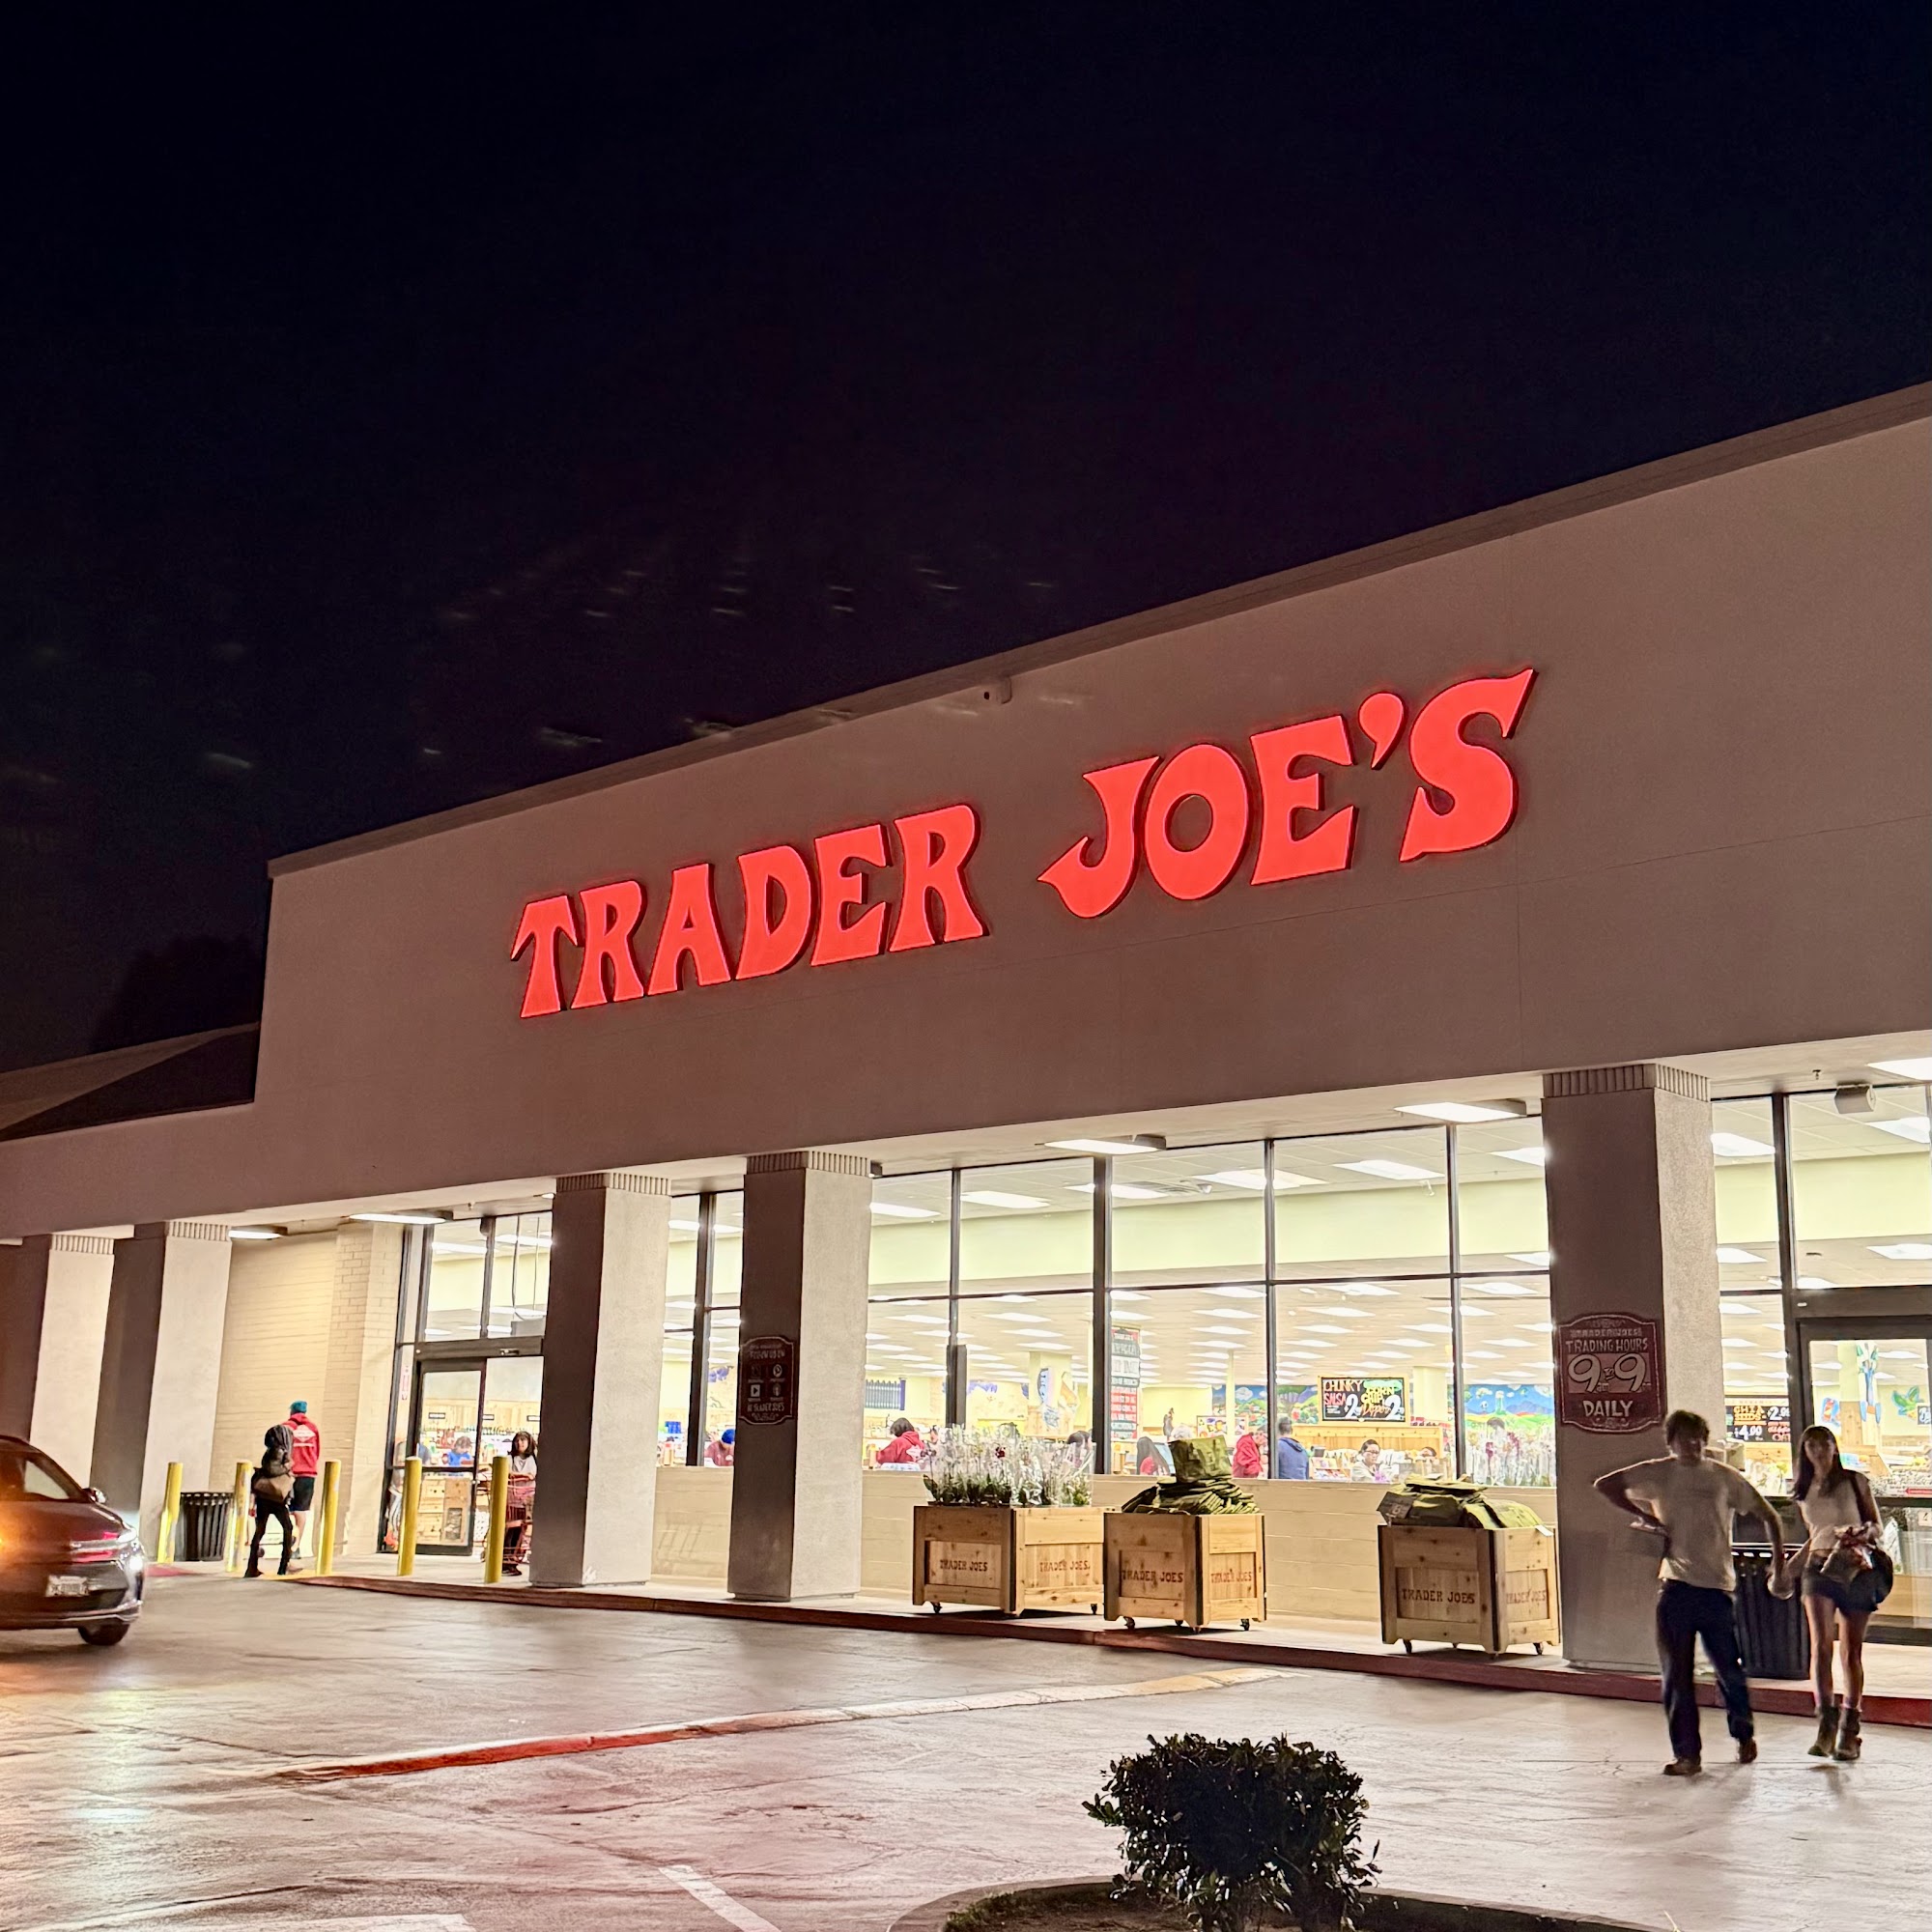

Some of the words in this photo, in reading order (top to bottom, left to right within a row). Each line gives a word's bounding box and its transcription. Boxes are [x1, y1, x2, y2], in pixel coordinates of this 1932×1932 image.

[510, 804, 985, 1018] TRADER
[1037, 667, 1535, 919] JOE'S
[1566, 1339, 1613, 1352] TRADING
[1615, 1338, 1648, 1351] HOURS
[1323, 1379, 1363, 1392] CHUNKY
[1582, 1400, 1634, 1416] DAILY
[939, 1559, 967, 1572] TRADER
[969, 1561, 988, 1573] JOES
[1122, 1570, 1156, 1582] TRADER
[1160, 1572, 1183, 1583] JOES
[1402, 1588, 1443, 1603] TRADER
[1447, 1591, 1475, 1605] JOES
